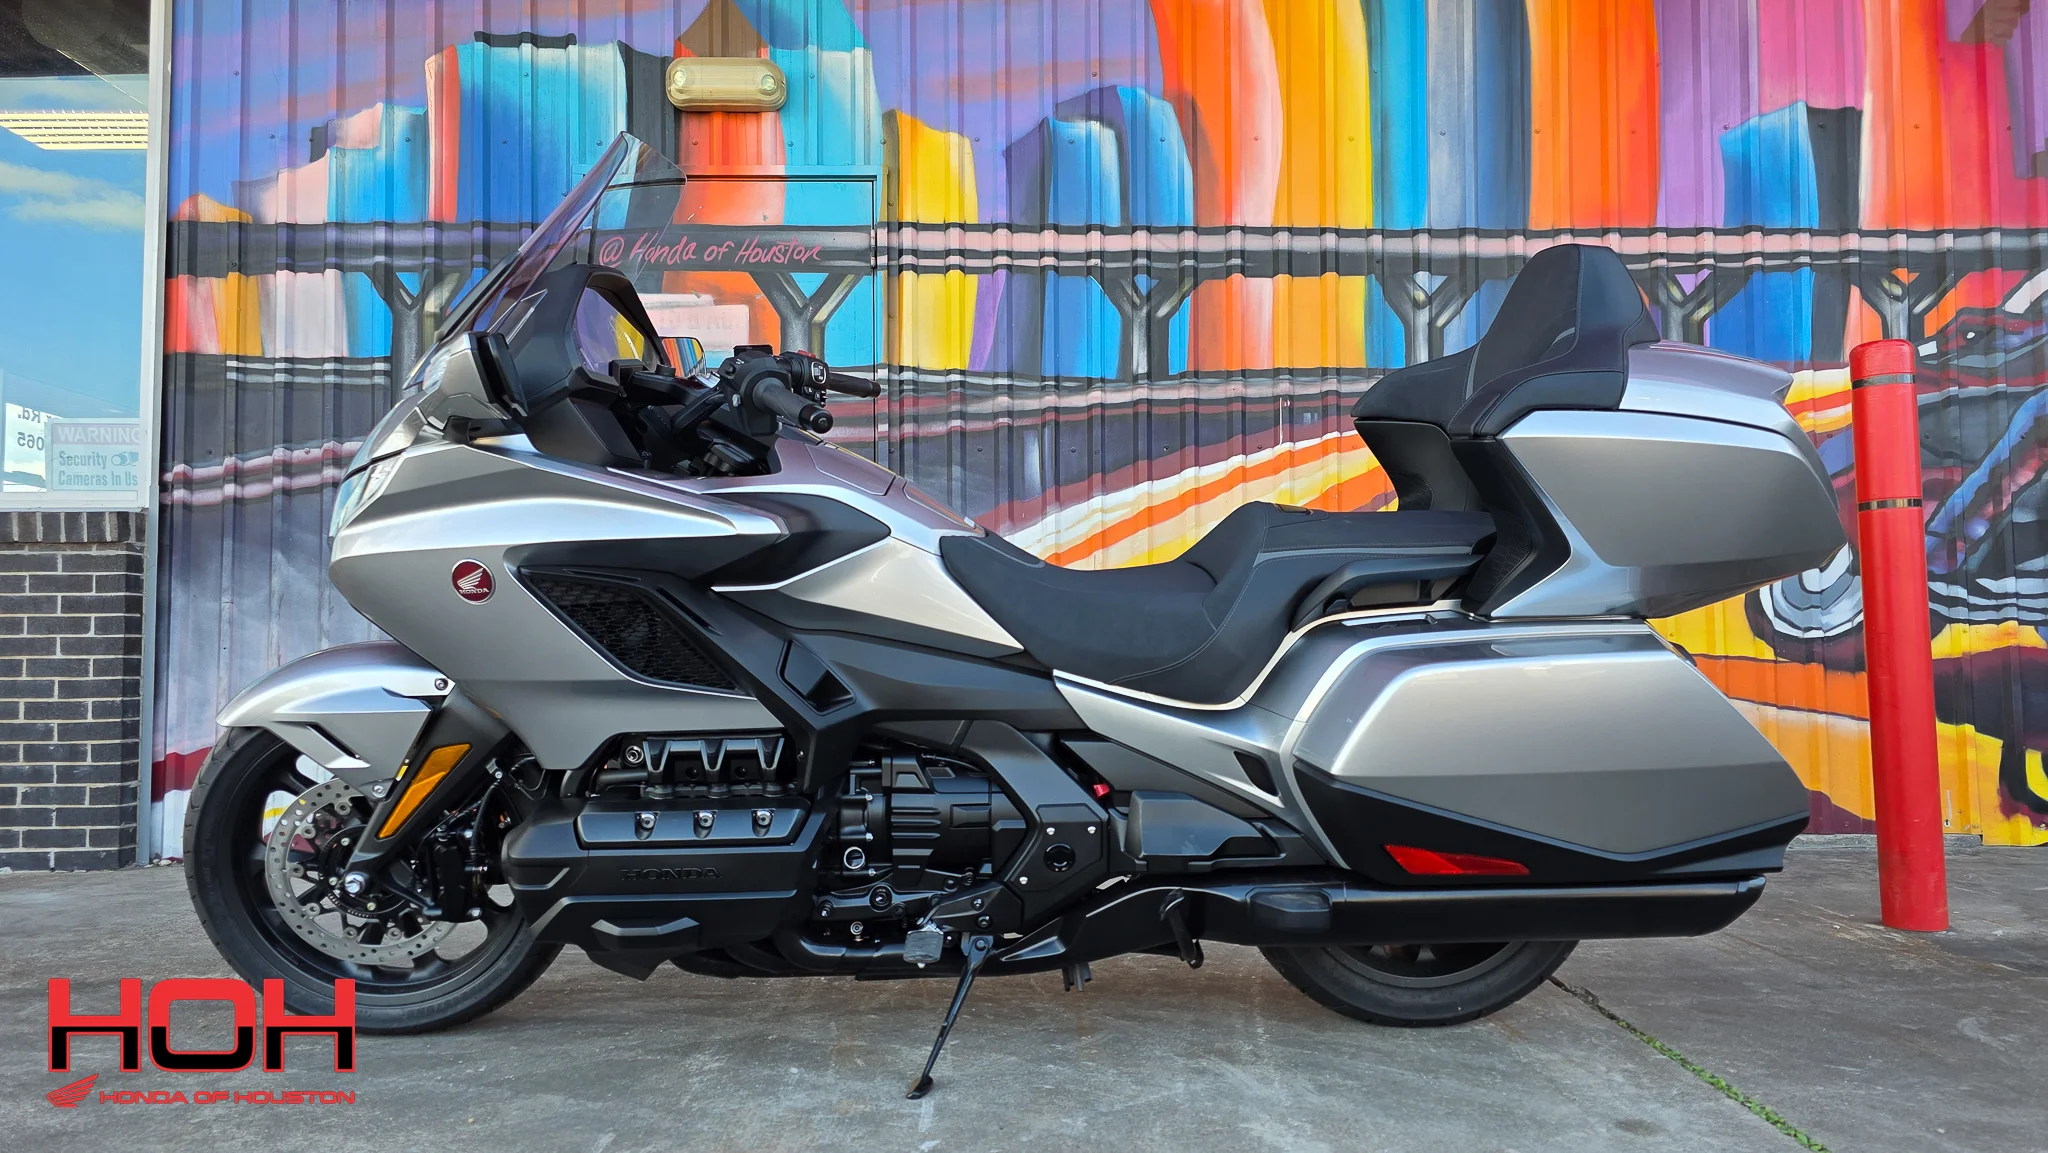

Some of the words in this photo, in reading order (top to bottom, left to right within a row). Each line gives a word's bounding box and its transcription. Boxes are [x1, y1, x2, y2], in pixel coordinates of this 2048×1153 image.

[599, 235, 625, 268] @
[628, 231, 697, 265] Honda
[703, 240, 735, 262] of
[734, 233, 822, 265] Houston
[58, 426, 140, 443] WARNING
[59, 451, 107, 469] Security
[58, 470, 108, 487] Cameras
[111, 471, 122, 487] In
[459, 587, 490, 595] HONDA
[621, 867, 723, 881] HONDA
